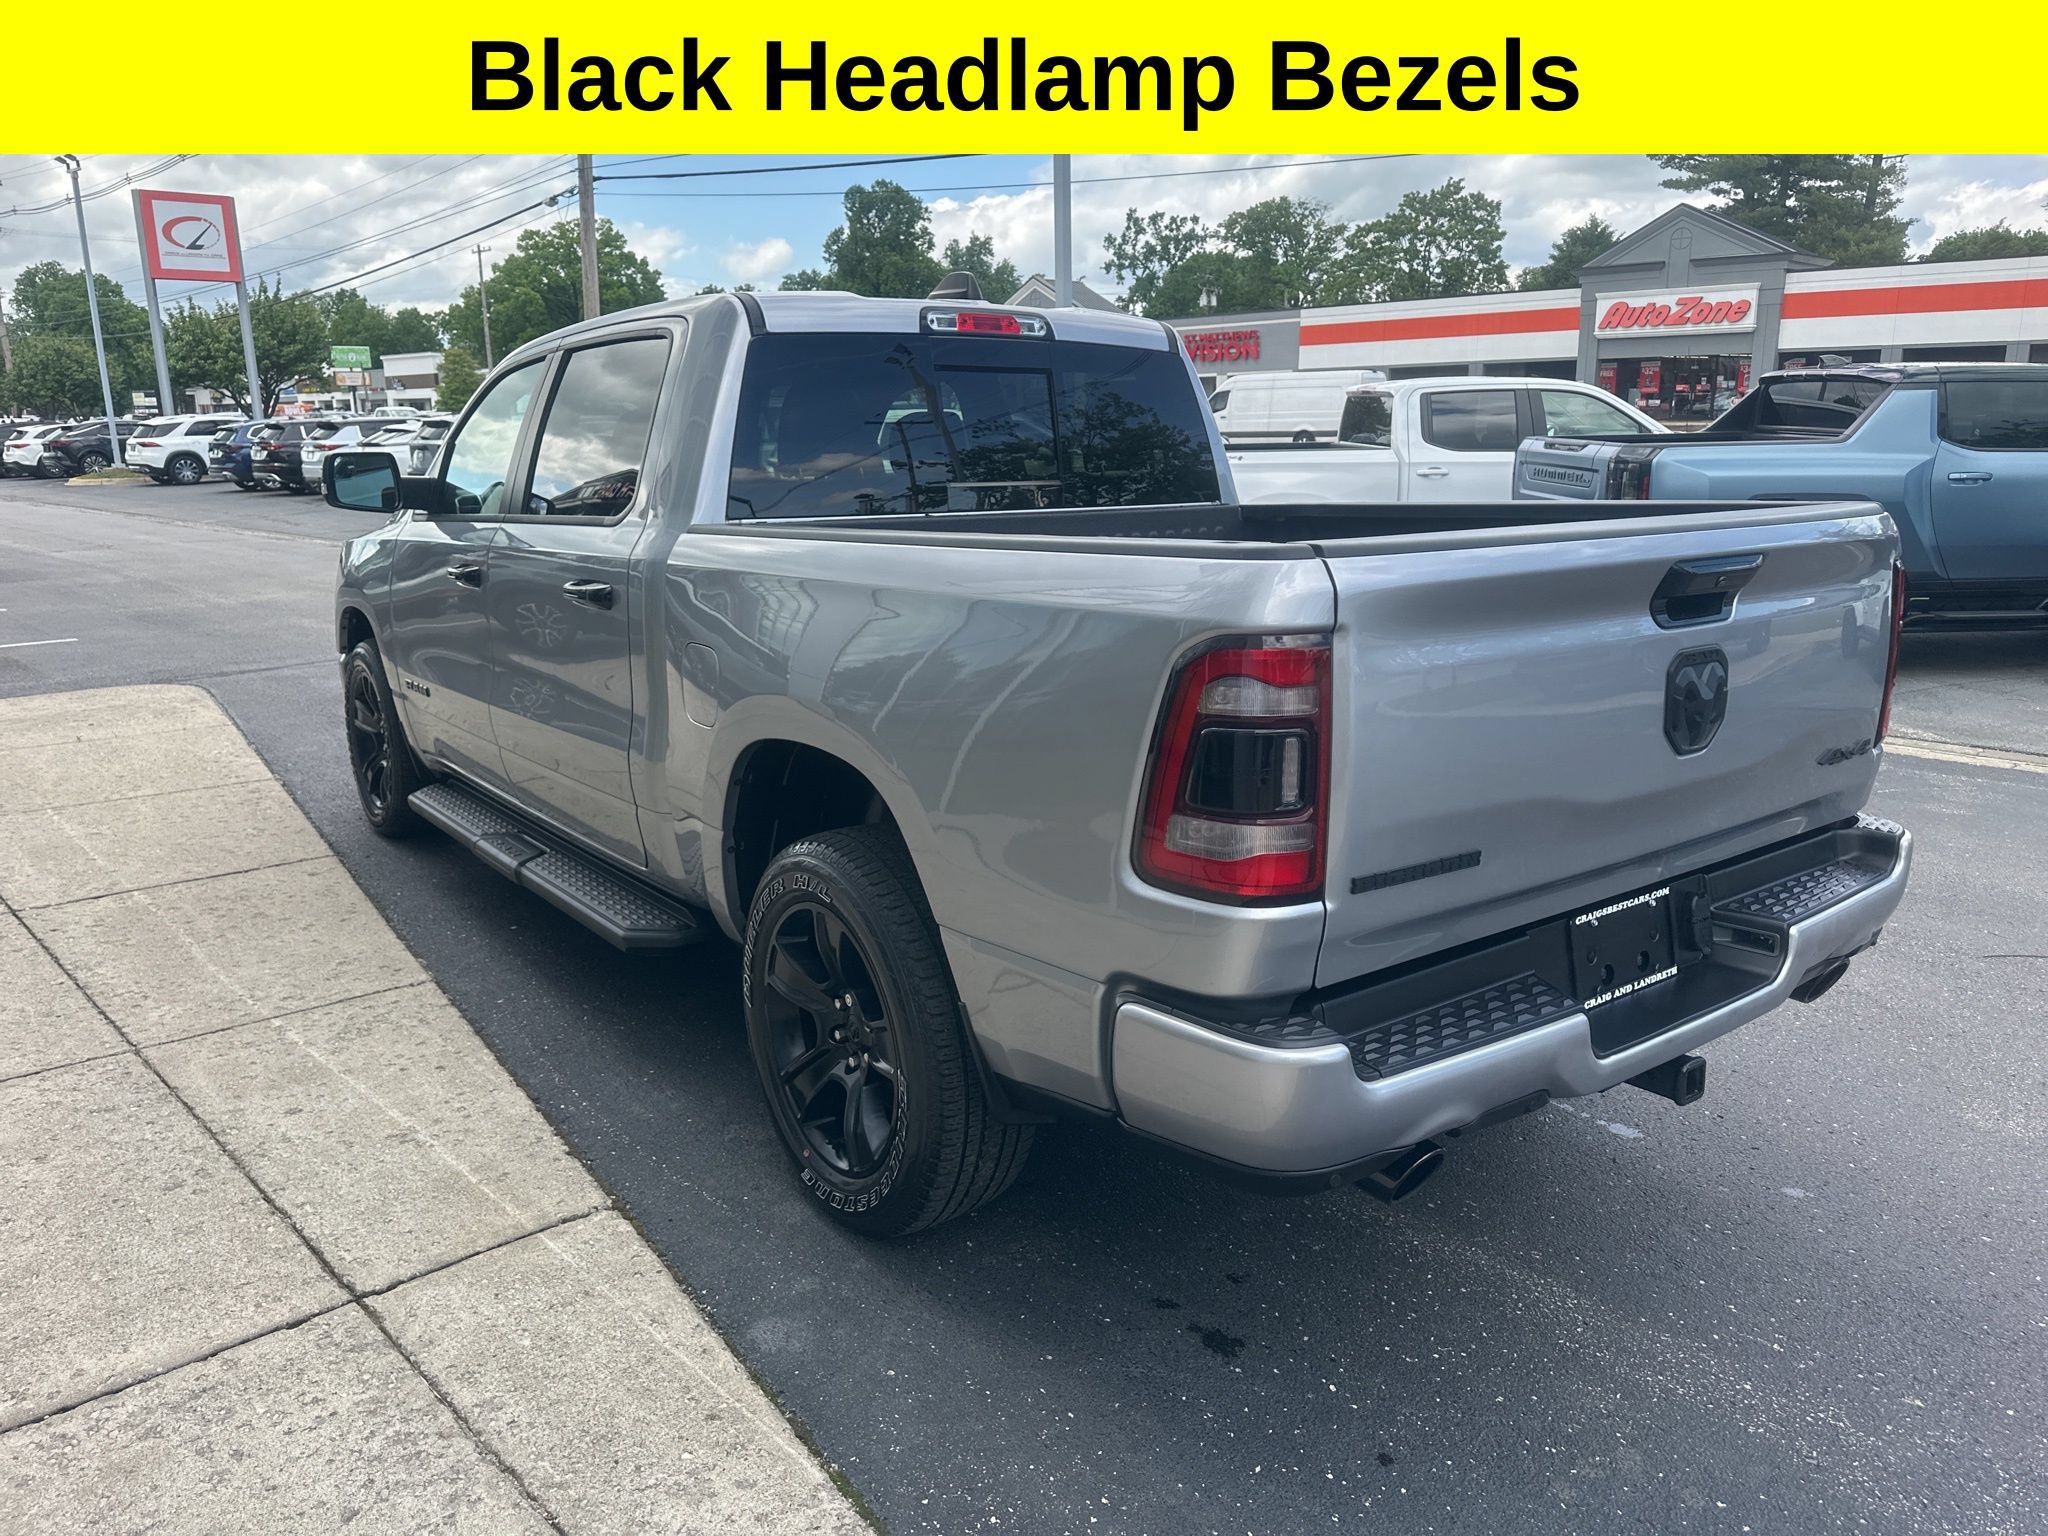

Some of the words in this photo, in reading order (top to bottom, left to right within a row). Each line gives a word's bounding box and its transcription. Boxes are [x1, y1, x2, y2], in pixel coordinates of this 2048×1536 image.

[1598, 296, 1752, 329] AutoZone
[1185, 341, 1260, 362] VISION
[1533, 467, 1584, 483] HUMMER
[1575, 886, 1671, 925] CRAIGSBESTCARS.COM
[1584, 992, 1612, 1010] CRAIG
[1613, 984, 1633, 998] AND
[1633, 966, 1678, 990] LANDRETH
